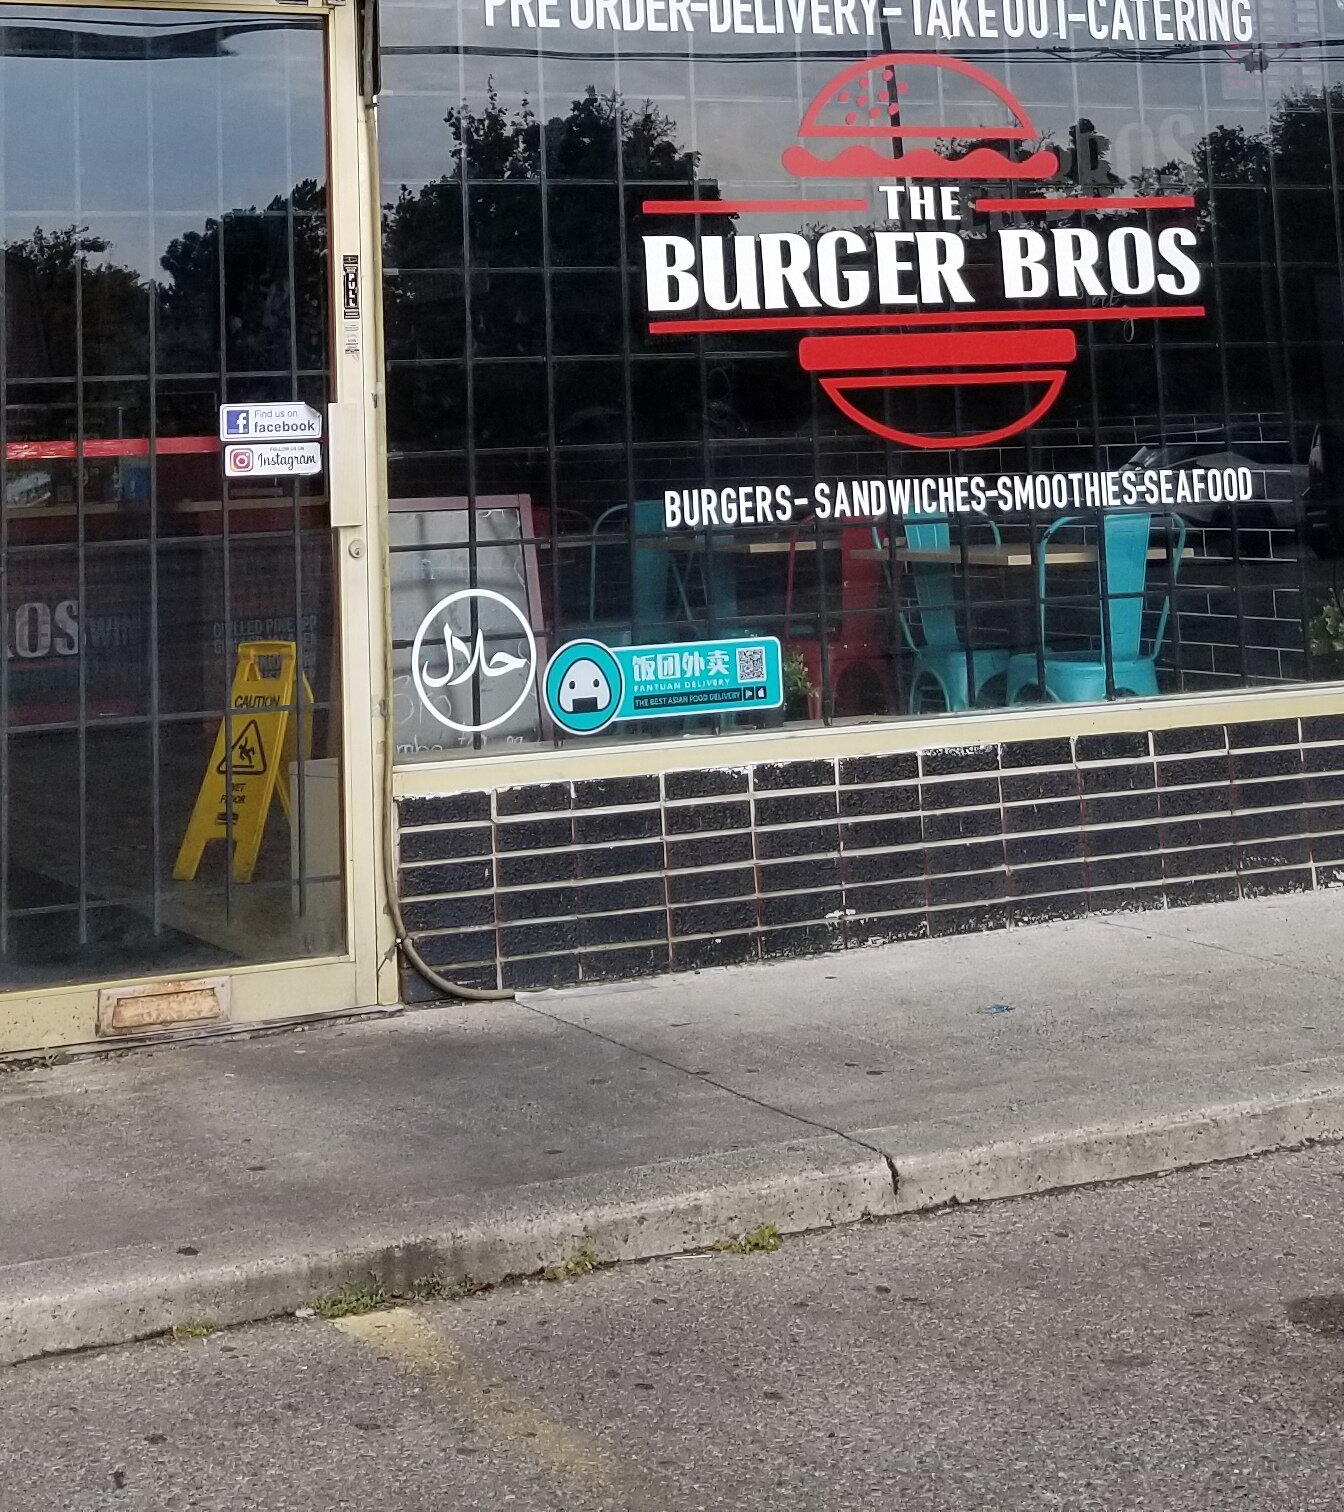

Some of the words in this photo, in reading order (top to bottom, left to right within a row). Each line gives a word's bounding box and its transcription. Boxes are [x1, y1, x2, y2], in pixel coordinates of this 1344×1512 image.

[878, 185, 962, 221] THE
[642, 230, 975, 312] BURGER
[999, 226, 1202, 299] BROS
[254, 420, 315, 433] facebook
[258, 452, 317, 471] Instagram
[422, 622, 527, 687] حلال
[632, 649, 731, 682] 饭团外卖
[234, 695, 281, 709] CAUTION
